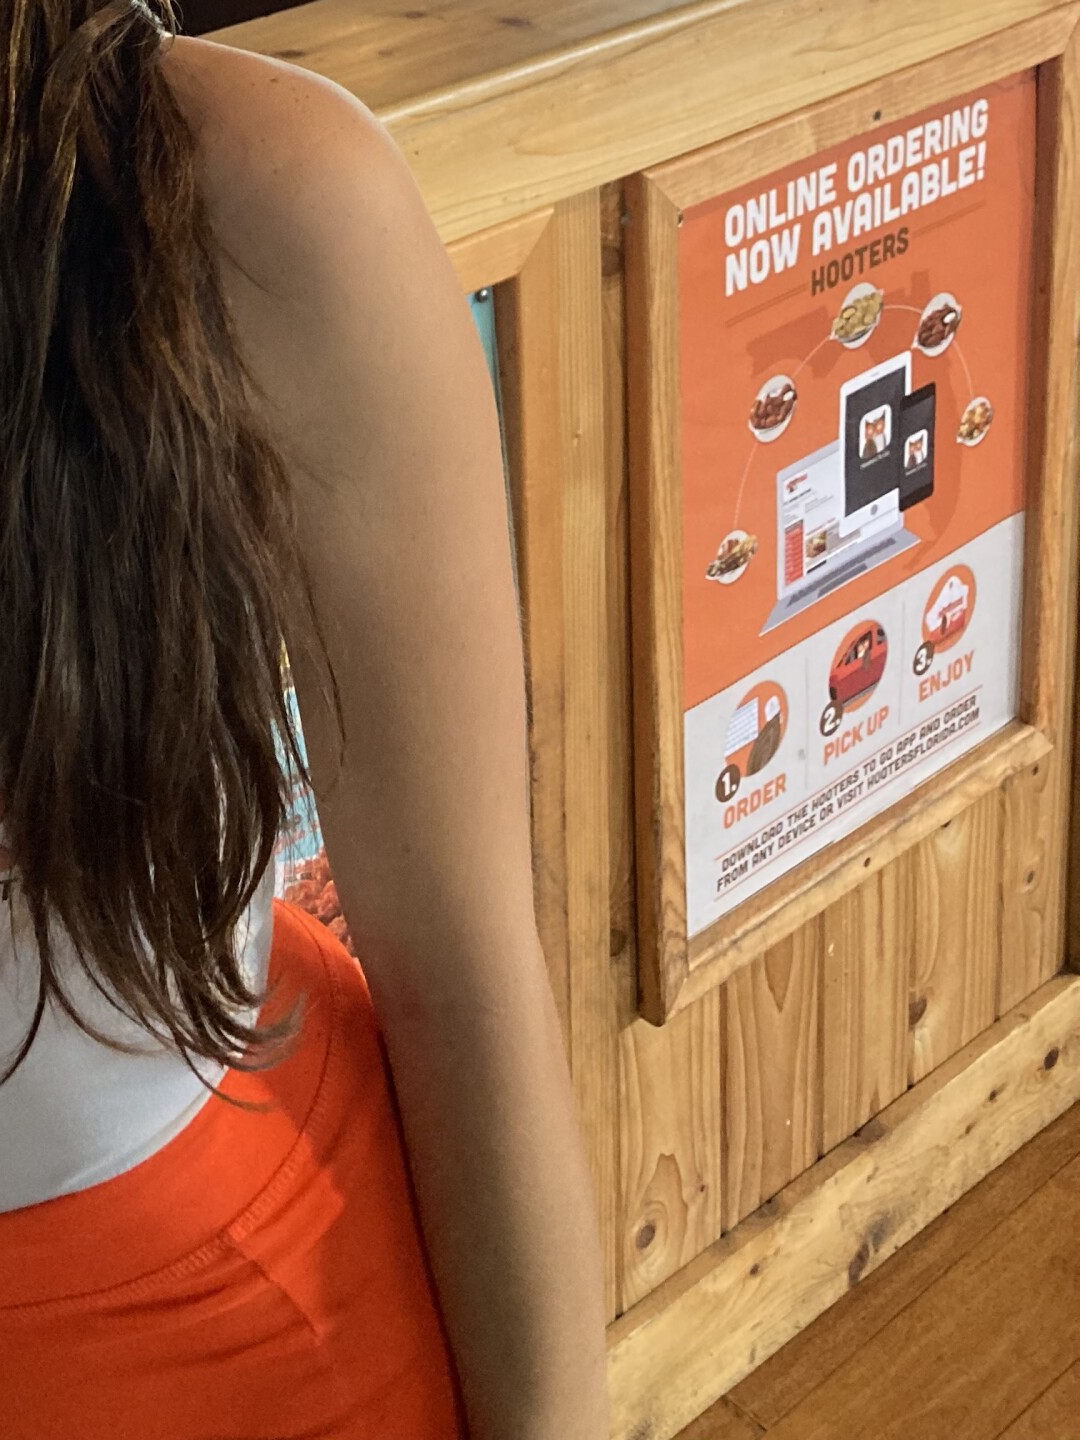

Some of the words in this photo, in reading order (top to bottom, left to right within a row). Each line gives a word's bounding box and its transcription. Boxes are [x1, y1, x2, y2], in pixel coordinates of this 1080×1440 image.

[724, 163, 838, 248] ONLINE
[847, 98, 989, 193] ORDERING
[725, 224, 801, 297] NOW
[812, 141, 987, 256] AVAILABLE!
[810, 227, 909, 297] HOOTERS
[919, 649, 975, 703] ENJOY
[823, 721, 863, 766] PICK
[866, 705, 890, 736] UP
[721, 822, 783, 872] DOWNLOAD
[787, 804, 809, 827] THE
[812, 770, 859, 812] HOOTERS
[863, 759, 877, 776] TO
[880, 748, 894, 765] GO
[896, 733, 917, 755] APP
[920, 718, 941, 741] AND
[944, 695, 977, 725] ORDER
[723, 773, 787, 829] ORDER
[716, 861, 749, 892] FROM
[752, 842, 775, 868] ANY
[778, 814, 817, 850] DEVICE
[819, 803, 834, 821] OR
[836, 781, 864, 810] VISIT
